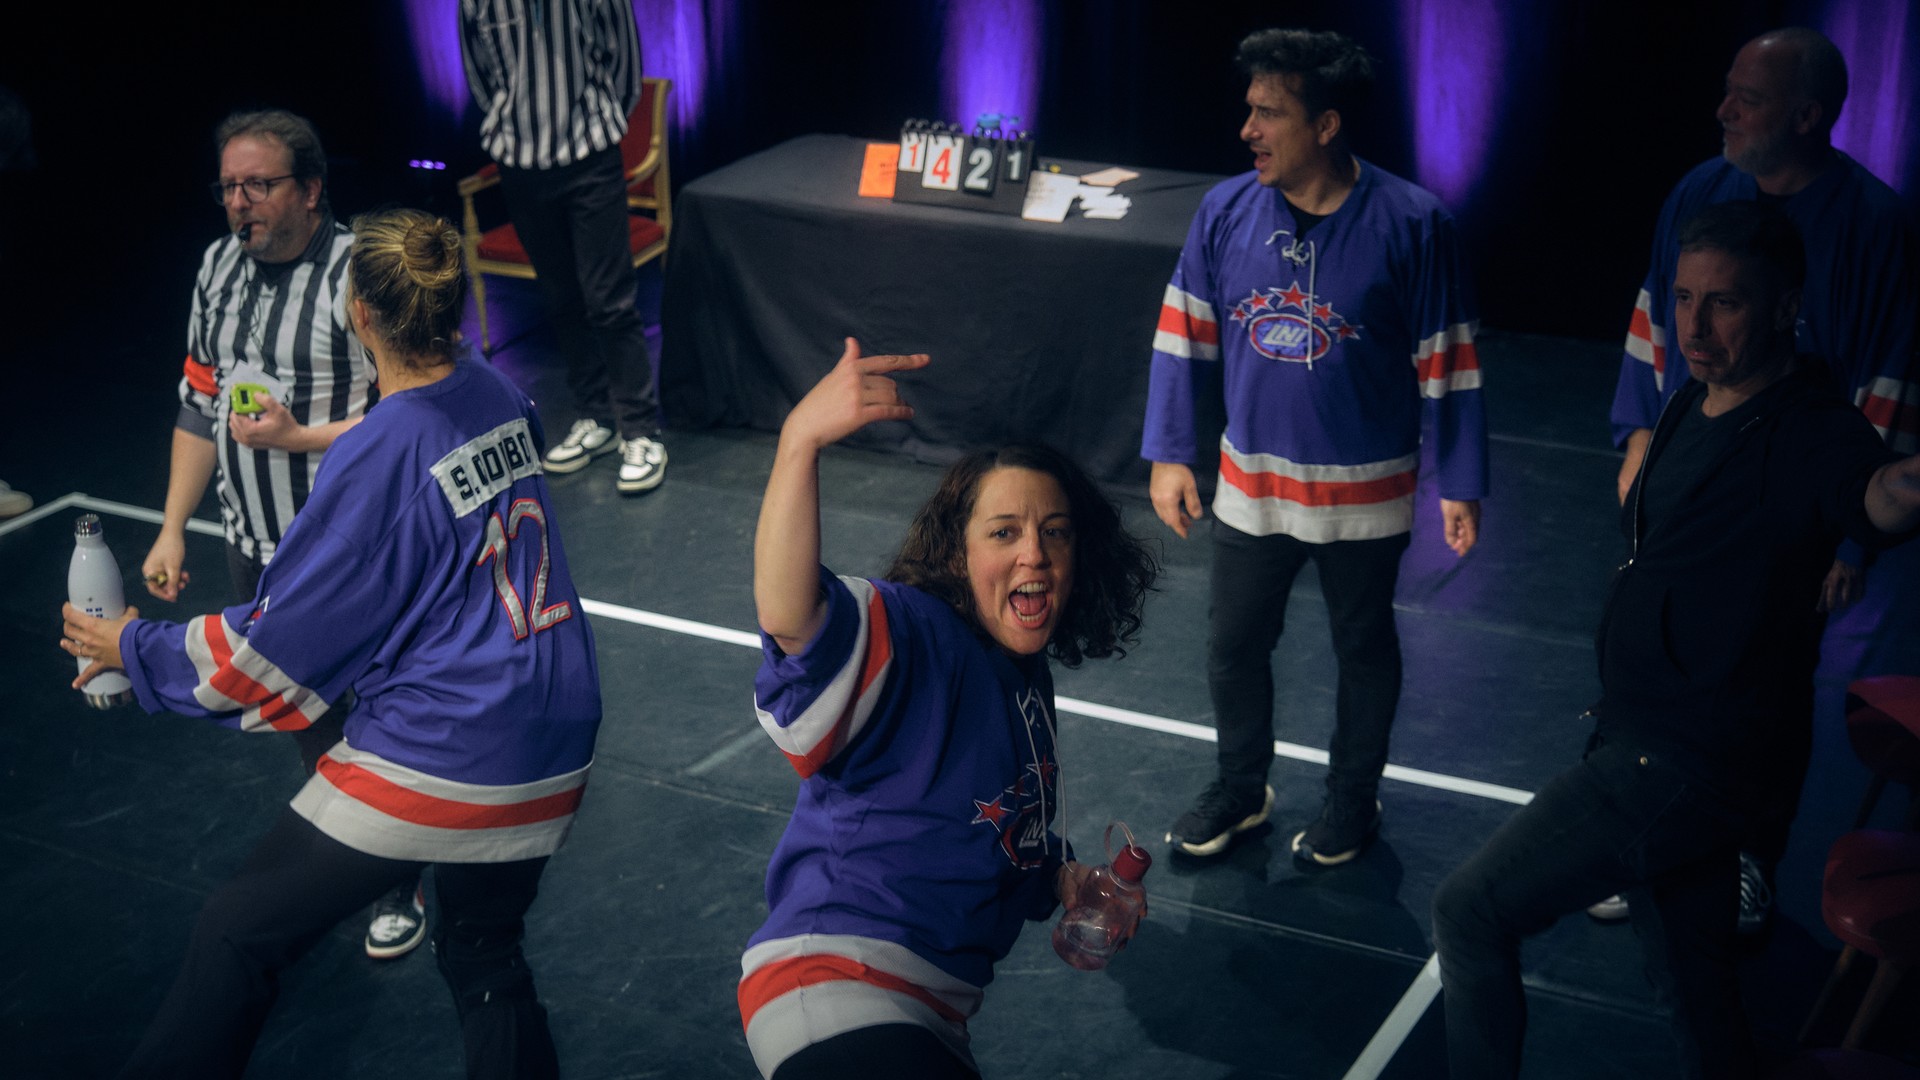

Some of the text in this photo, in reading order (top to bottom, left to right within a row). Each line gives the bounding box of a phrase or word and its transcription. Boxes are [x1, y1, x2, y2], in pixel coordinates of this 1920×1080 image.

[908, 143, 921, 168] 1
[932, 148, 951, 184] 4
[964, 148, 993, 190] 2
[1007, 150, 1023, 181] 1
[476, 498, 571, 640] 12
